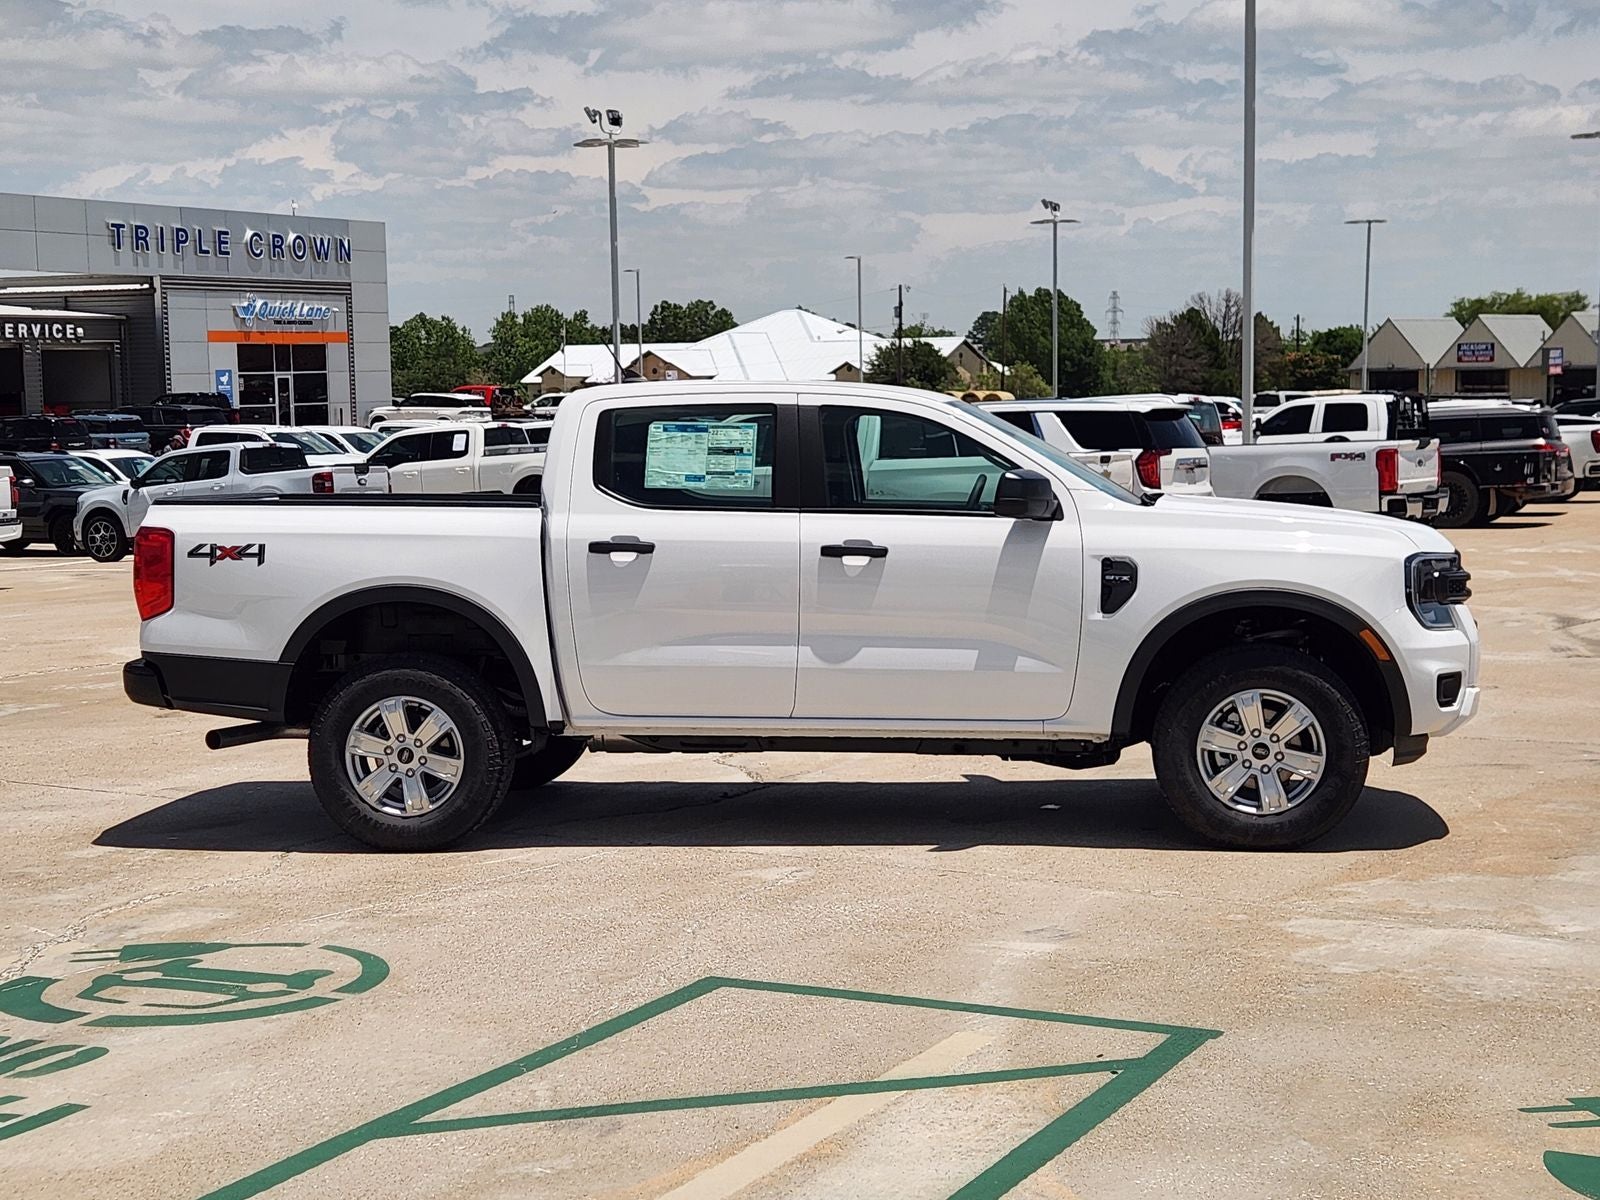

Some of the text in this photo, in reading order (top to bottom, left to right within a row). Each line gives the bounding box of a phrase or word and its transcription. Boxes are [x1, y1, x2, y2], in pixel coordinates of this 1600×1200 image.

[109, 222, 352, 262] TRIPLE CROWN
[258, 301, 331, 320] Quick Lane
[0, 323, 75, 339] ERVICE
[1330, 452, 1366, 462] FX4
